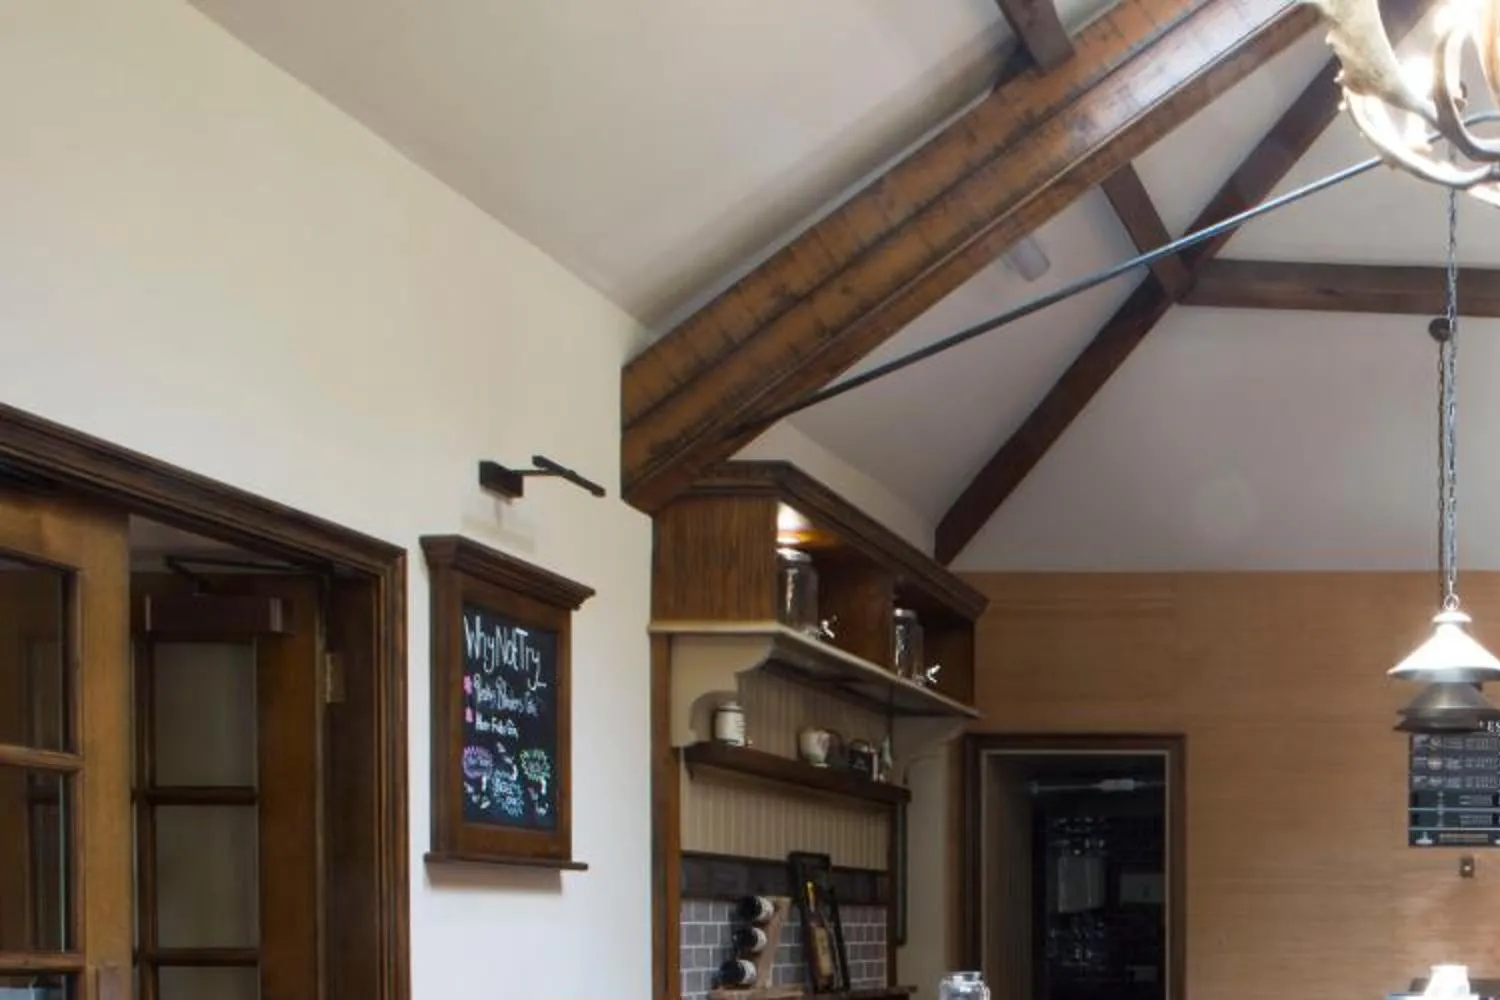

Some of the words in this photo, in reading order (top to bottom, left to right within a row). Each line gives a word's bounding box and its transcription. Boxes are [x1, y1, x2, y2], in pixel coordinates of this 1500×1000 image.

[464, 615, 495, 673] Why
[495, 625, 518, 671] Not
[515, 627, 547, 691] Try
